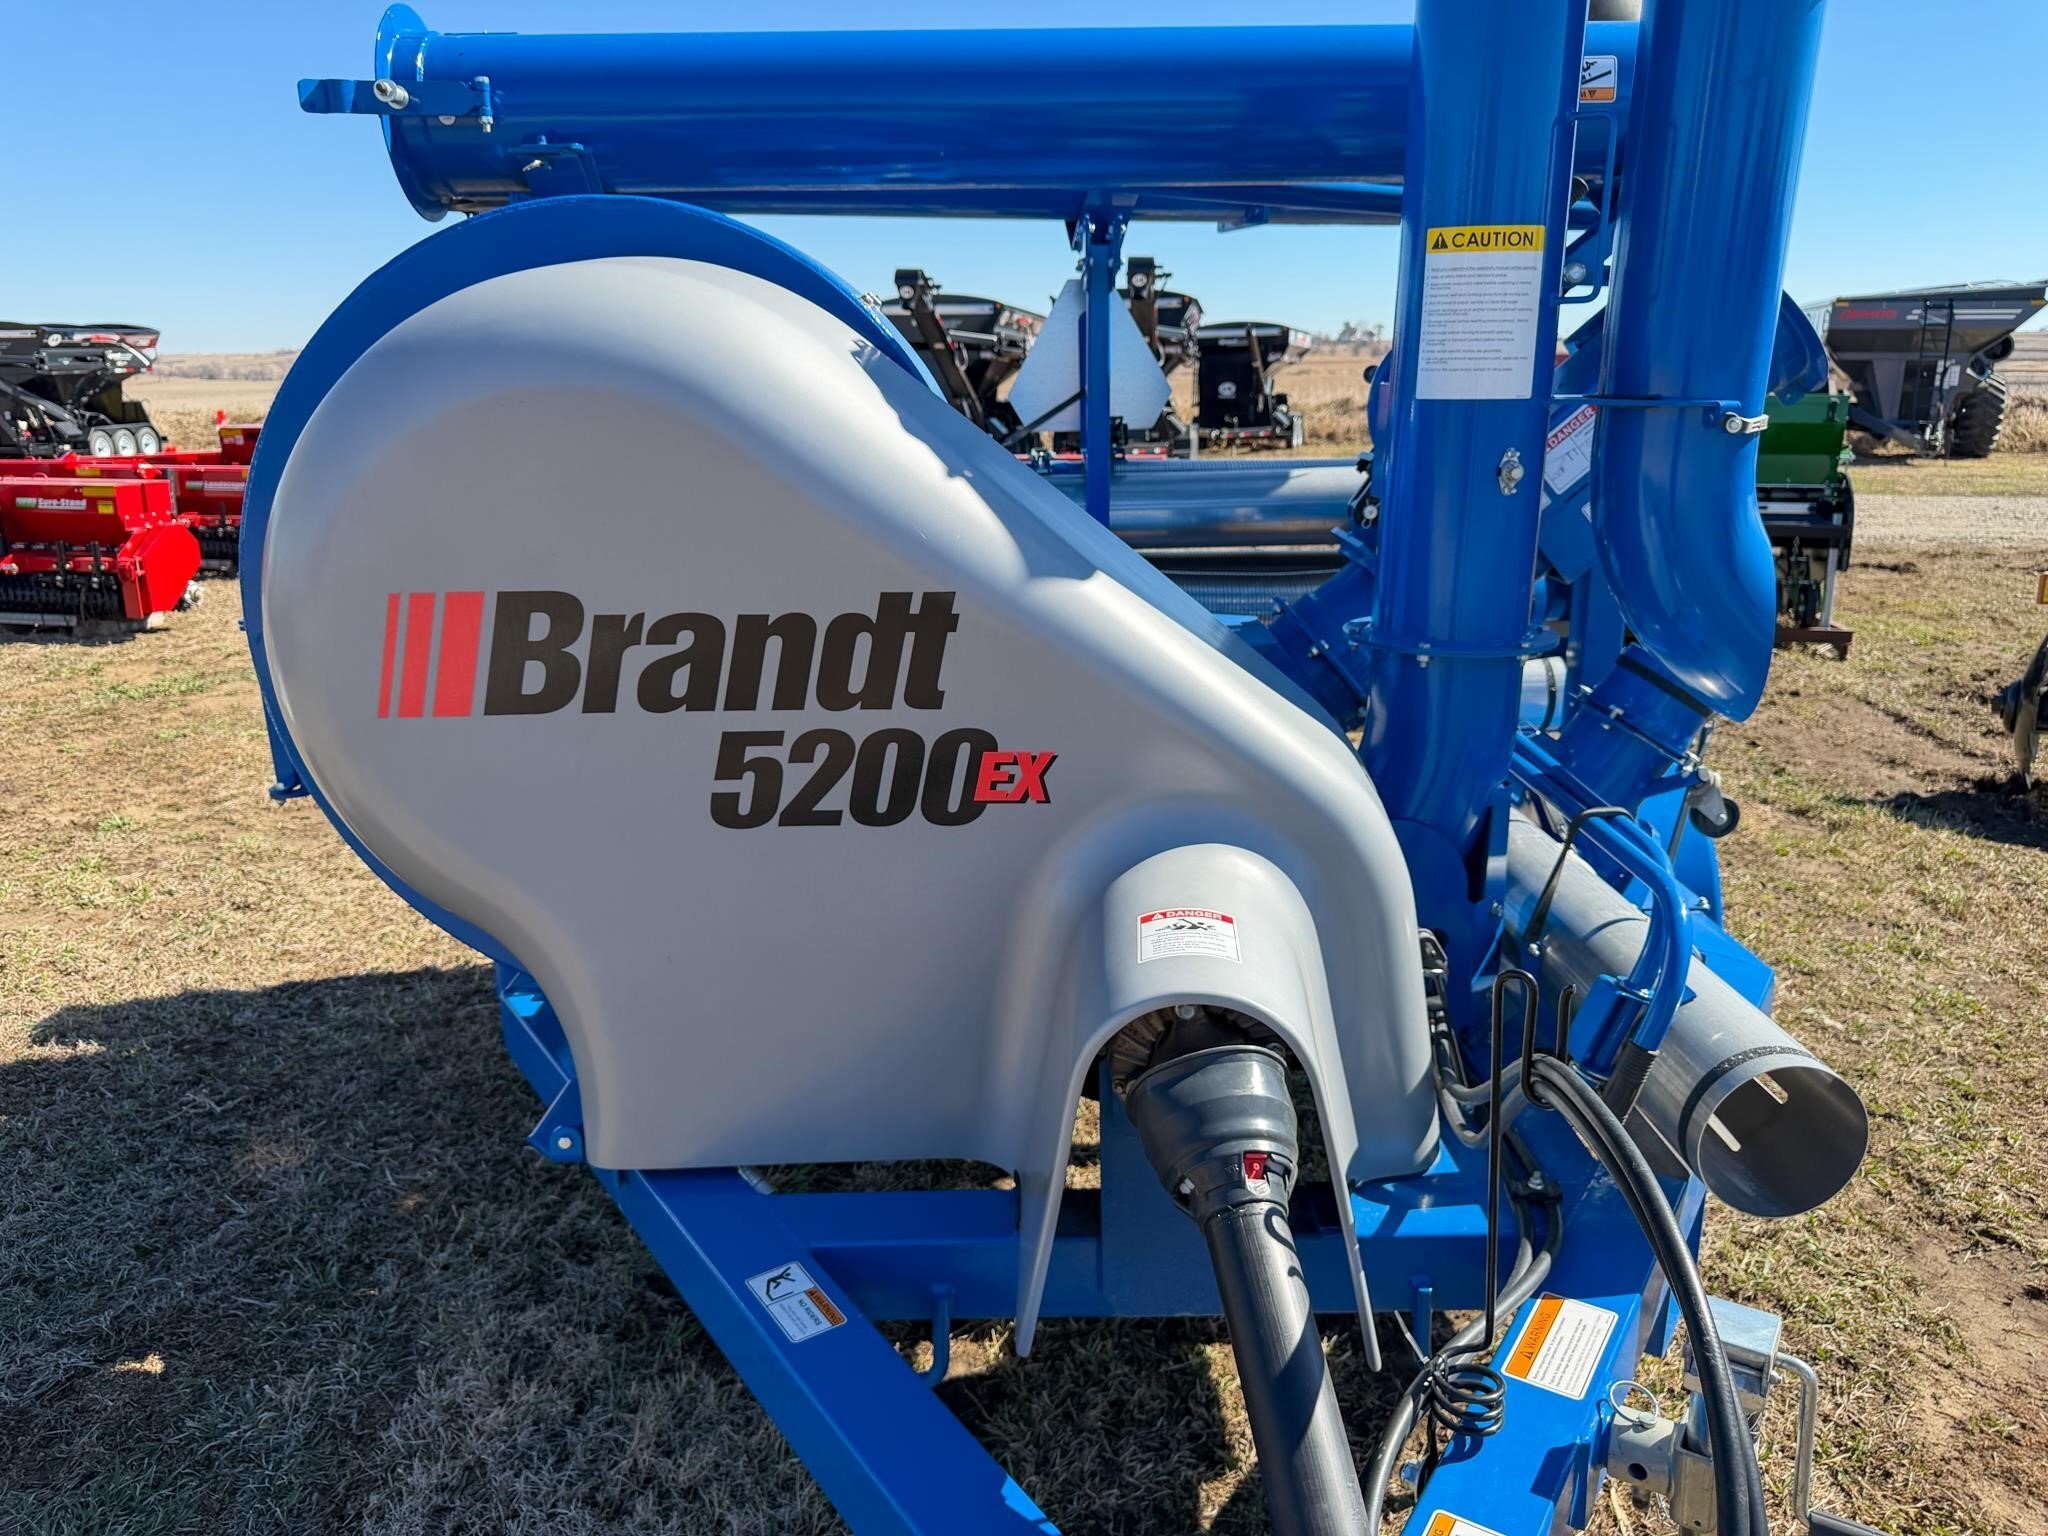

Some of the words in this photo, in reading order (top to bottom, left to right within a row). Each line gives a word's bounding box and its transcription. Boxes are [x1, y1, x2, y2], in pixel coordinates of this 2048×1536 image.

[1451, 231, 1534, 248] CAUTION
[1549, 406, 1594, 449] DANGER
[483, 590, 960, 716] Brandt
[710, 727, 999, 830] 5200
[972, 751, 1058, 805] EX
[1165, 910, 1223, 921] DANGER
[813, 1292, 842, 1324] WARNING
[1526, 1312, 1551, 1352] WARNING
